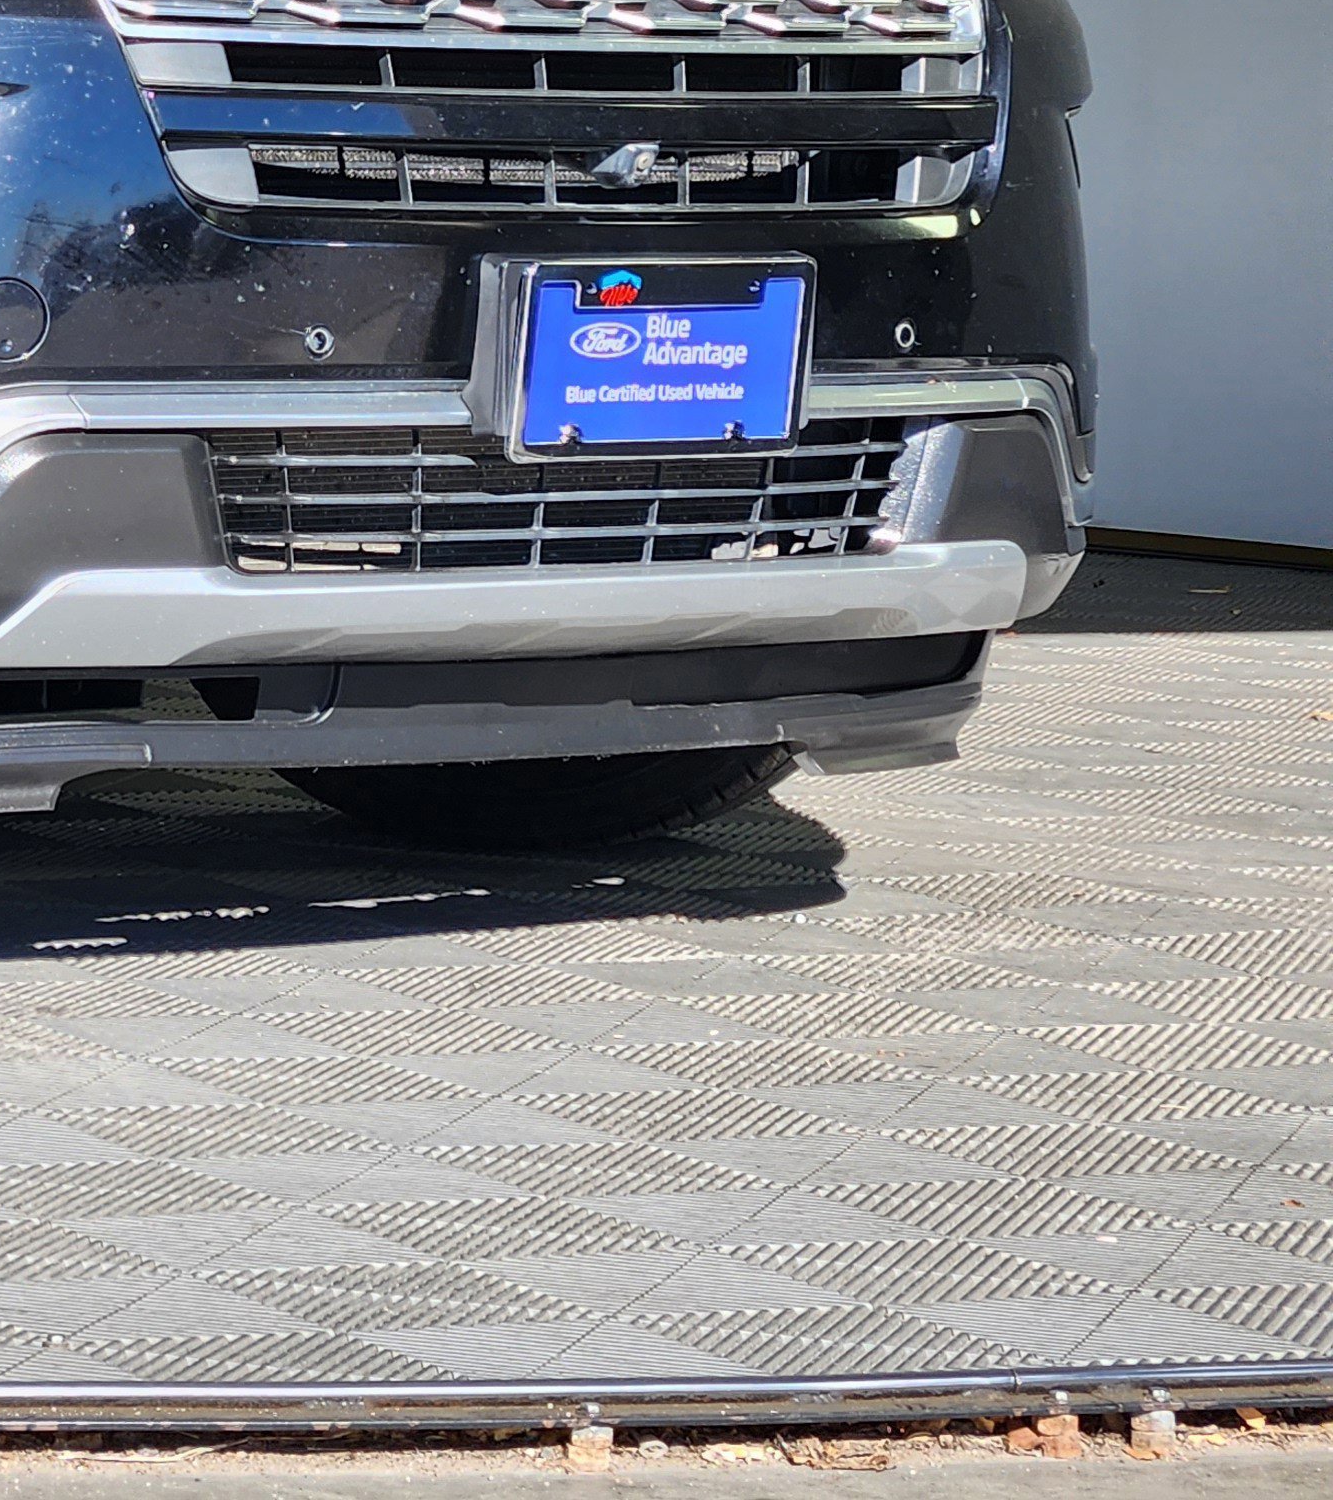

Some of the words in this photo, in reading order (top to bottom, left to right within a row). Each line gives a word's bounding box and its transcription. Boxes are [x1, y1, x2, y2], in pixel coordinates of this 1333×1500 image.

[646, 314, 691, 338] Blue
[583, 327, 629, 353] Ford
[642, 341, 748, 369] Advantage
[565, 385, 597, 404] Blue
[598, 384, 656, 402] Certified
[658, 383, 693, 401] Used
[695, 382, 745, 400] Vehicle
